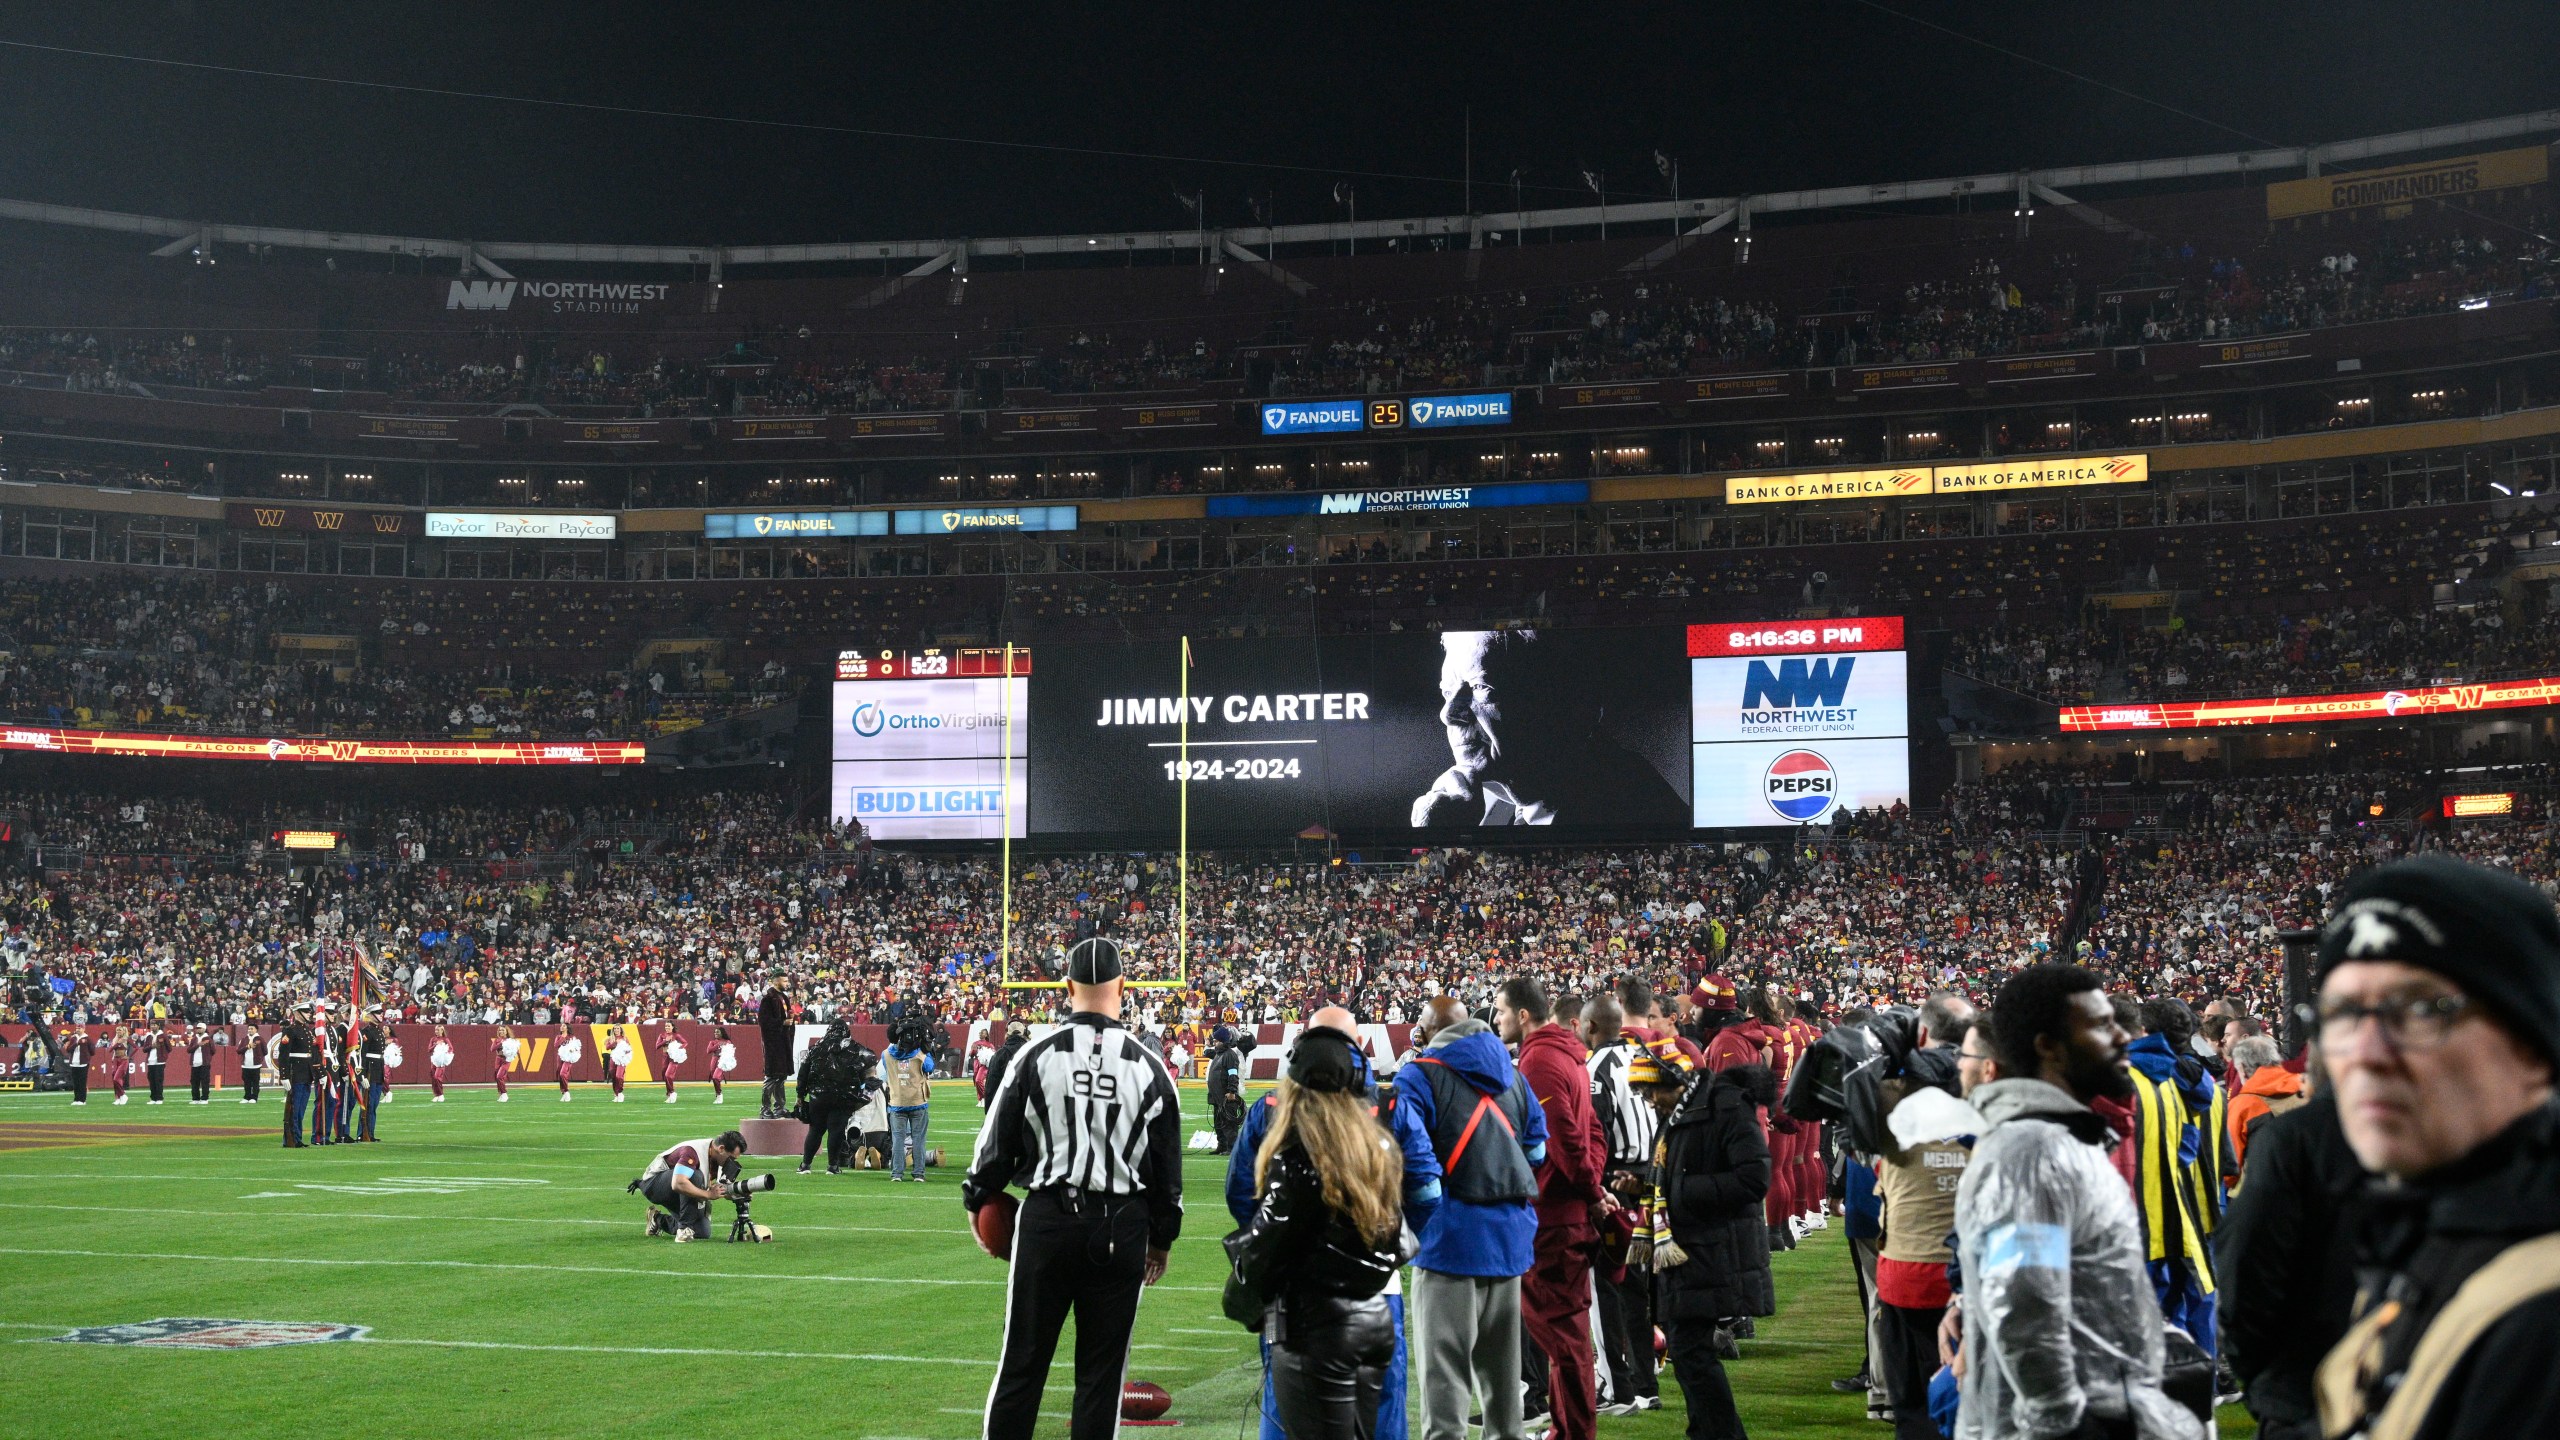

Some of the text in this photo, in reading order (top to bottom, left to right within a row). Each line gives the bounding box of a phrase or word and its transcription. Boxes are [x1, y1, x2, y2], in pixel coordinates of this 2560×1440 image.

[2332, 169, 2477, 208] COMMANDERS
[523, 282, 669, 300] NORTHWEST
[553, 301, 640, 314] STADIUM
[2222, 346, 2240, 361] 80
[1863, 372, 1880, 385] 22
[1577, 390, 1593, 403] 66
[1697, 383, 1711, 397] 51
[1139, 410, 1154, 424] 68
[1290, 410, 1360, 425] FANDUEL
[1374, 405, 1398, 423] 25
[1436, 402, 1508, 418] FANDUEL
[857, 420, 872, 433] 55
[1019, 415, 1034, 428] 53
[744, 423, 758, 436] 17
[1942, 468, 2096, 488] BANK OF AMERICA
[1366, 488, 1472, 504] NORTHWEST
[1736, 481, 1884, 499] BANK OF AMERICA
[1366, 501, 1469, 513] FEDERAL CREDIT UNION
[775, 519, 835, 531] FANDUEL
[963, 514, 1024, 527] FANDUEL
[431, 521, 485, 536] Paycor
[496, 521, 550, 537] Paycor
[560, 521, 614, 538] Paycor
[1729, 627, 1862, 647] 8:16:36 PM
[839, 649, 893, 660] ATL 0
[839, 663, 893, 674] WAS 0
[911, 656, 948, 675] 5:23
[1741, 656, 1856, 710] NW
[2294, 701, 2372, 713] FALCONS
[2418, 694, 2440, 706] VS
[1097, 692, 1370, 726] JIMMY CARTER
[889, 712, 1008, 730] OrthoVirginia
[1741, 709, 1858, 725] NORTHWEST
[1741, 723, 1855, 734] FEDERAL CREDIT UNION
[185, 743, 256, 753] FALCONS
[297, 745, 319, 755] VS
[368, 748, 469, 757] COMMANDERS
[1164, 757, 1301, 781] 1924-2024
[1769, 777, 1832, 793] PEPSI
[857, 790, 1001, 812] BUD LIGHT
[2078, 817, 2097, 826] 234
[593, 839, 611, 848] 229
[1072, 1070, 1117, 1100] 89
[1923, 1151, 1967, 1168] MEDIA
[1937, 1174, 1958, 1192] 93
